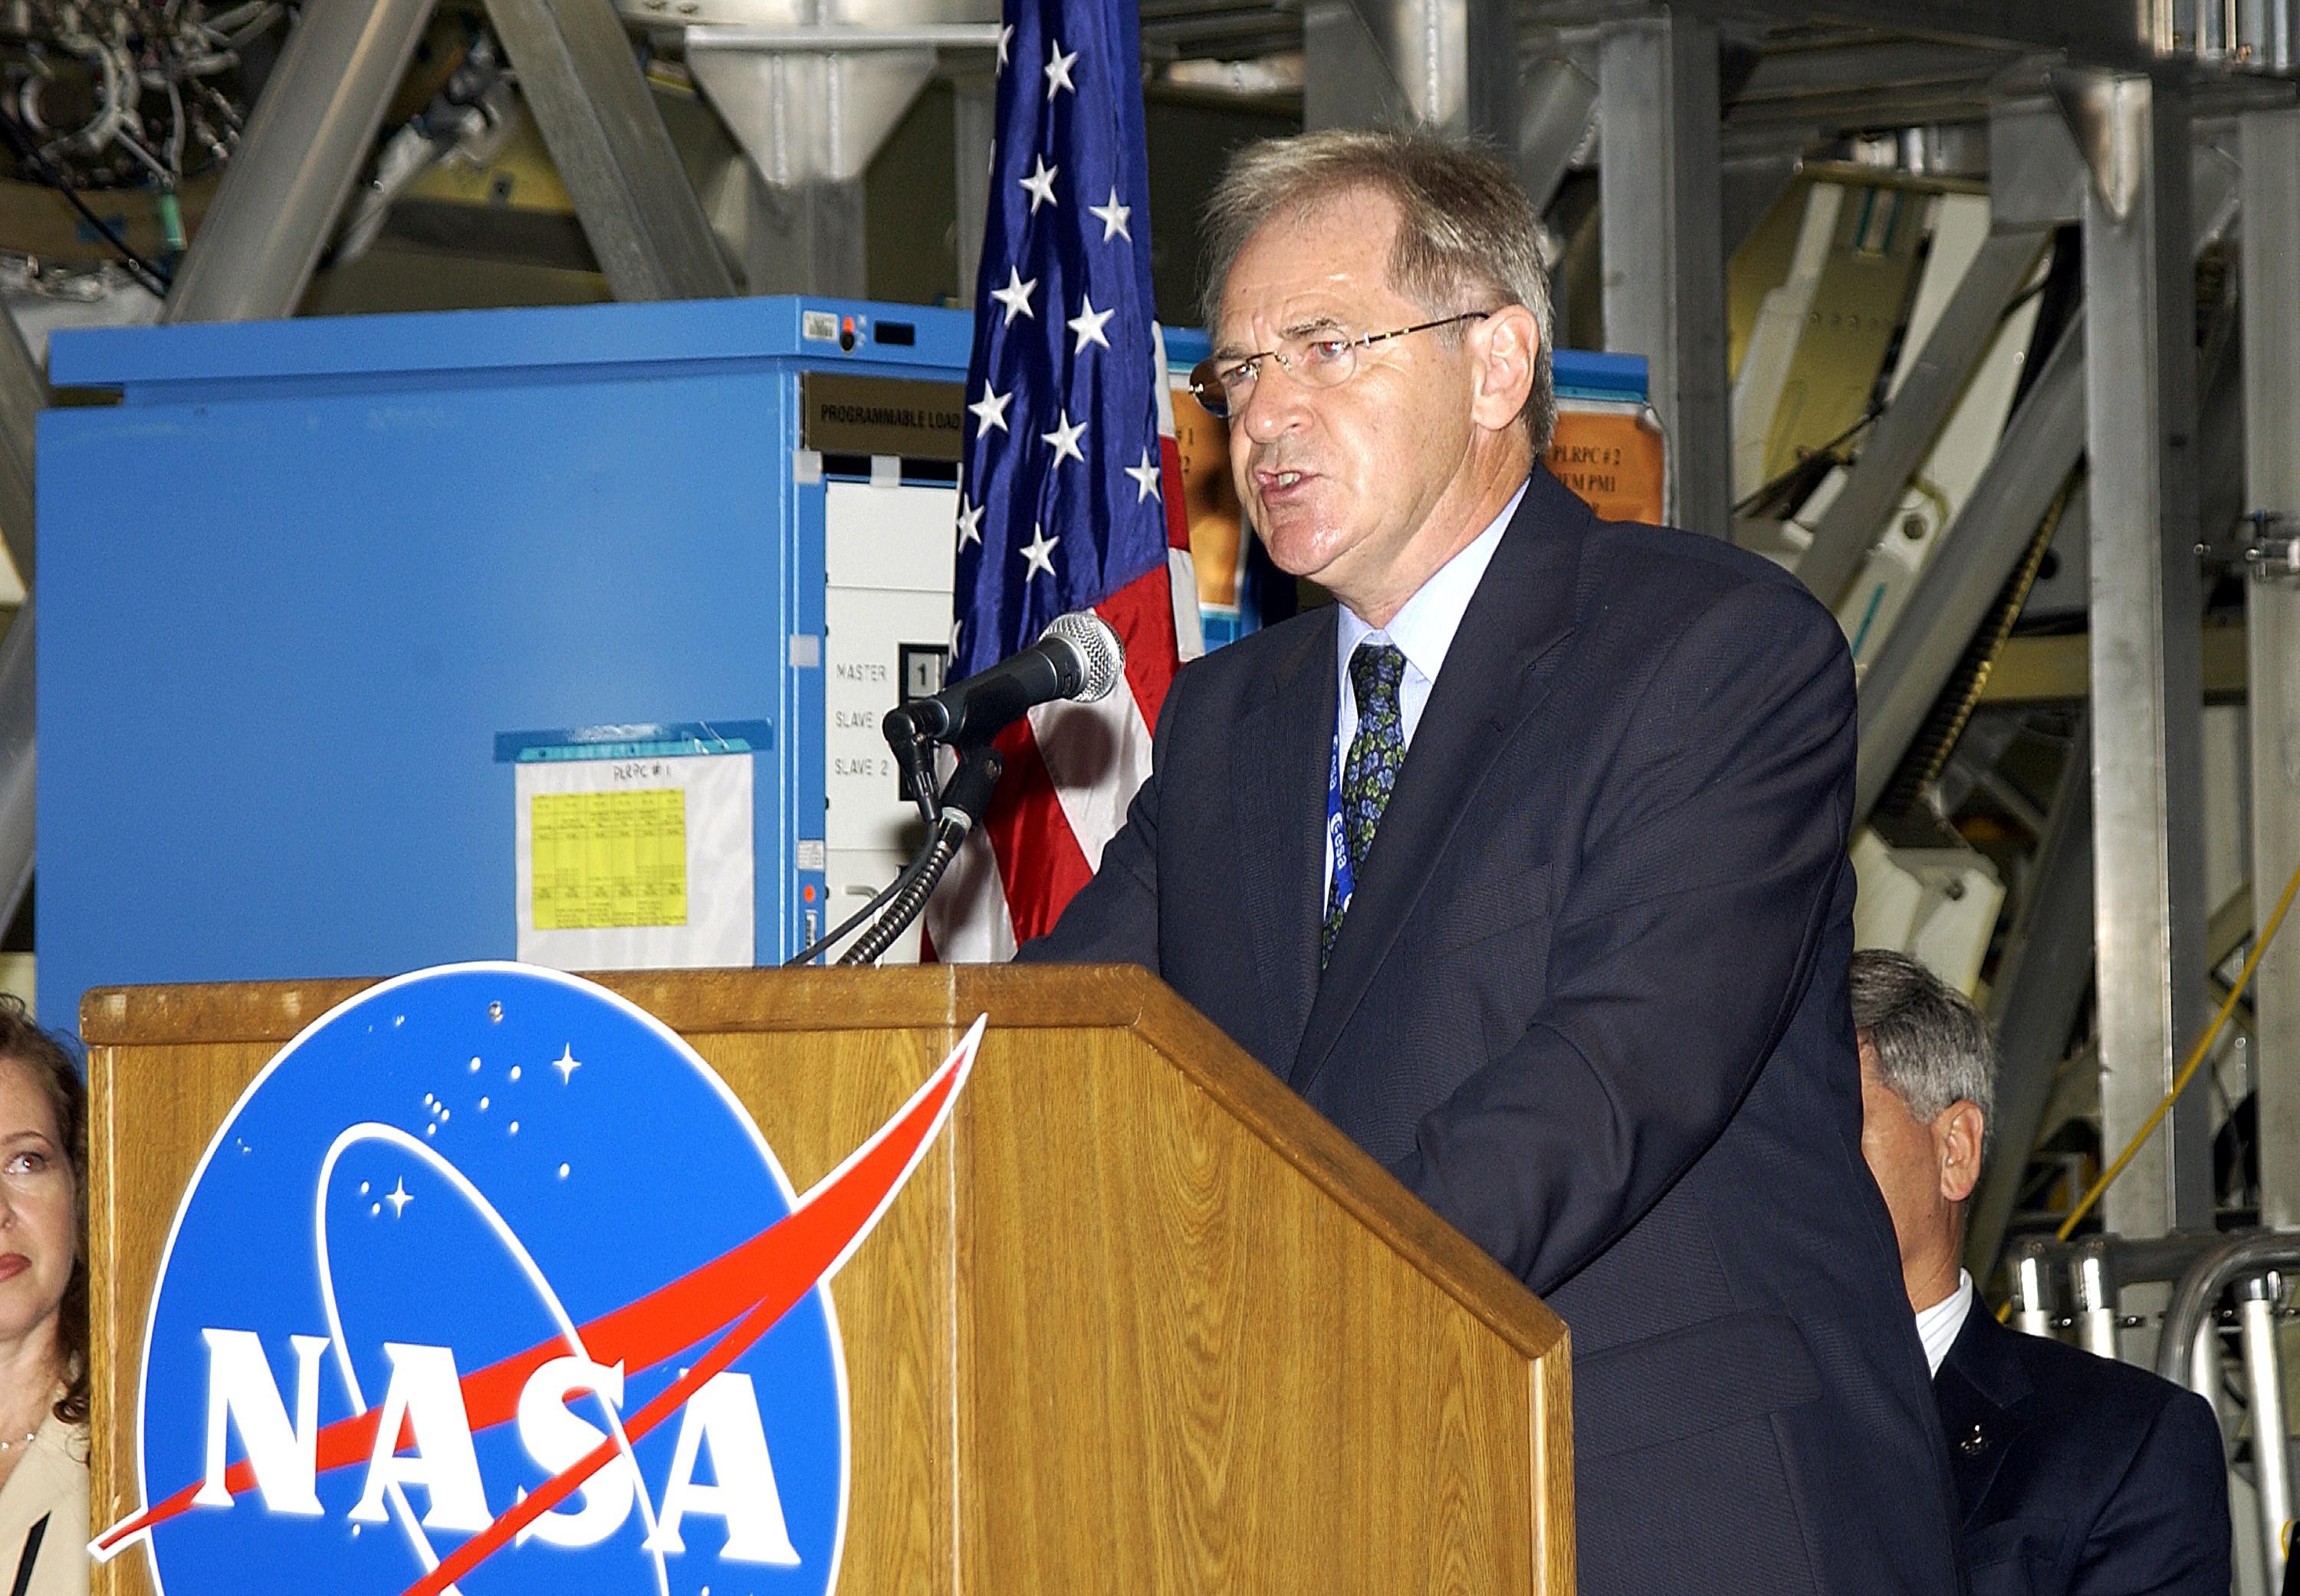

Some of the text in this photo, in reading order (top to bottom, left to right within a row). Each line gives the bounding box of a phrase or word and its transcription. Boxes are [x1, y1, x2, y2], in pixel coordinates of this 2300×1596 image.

[821, 404, 960, 429] PROGRAMMABLE LOAD
[836, 664, 886, 681] MASTER
[918, 663, 926, 686] 1
[836, 711, 873, 728] SLAVE
[834, 758, 889, 776] SLAVE 2
[1334, 835, 1348, 870] esa
[191, 1327, 802, 1565] NASA
